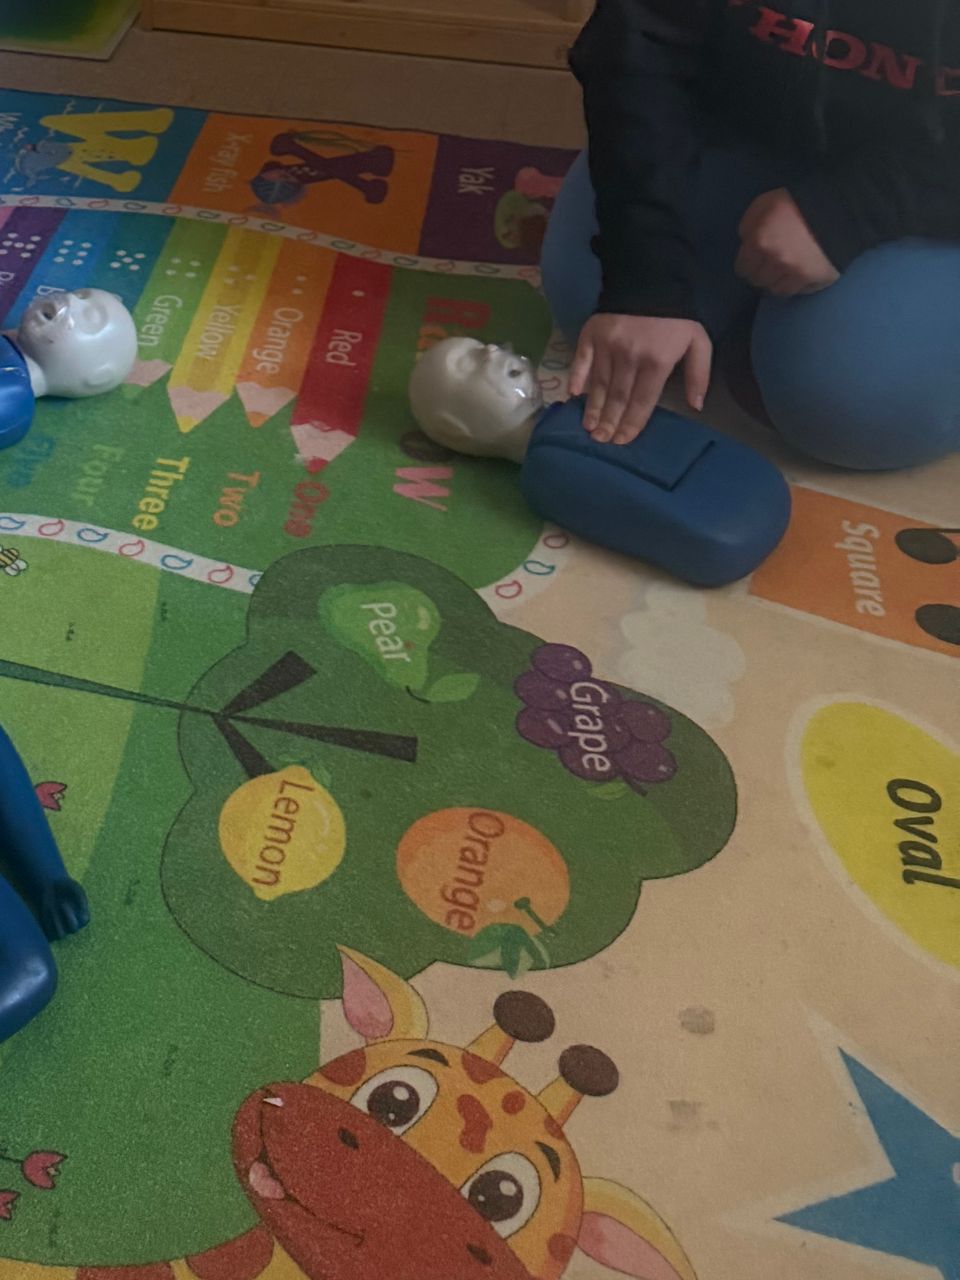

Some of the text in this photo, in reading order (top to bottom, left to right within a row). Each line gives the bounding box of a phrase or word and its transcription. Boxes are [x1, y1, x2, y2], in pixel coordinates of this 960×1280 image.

[457, 166, 495, 196] Yak
[138, 294, 183, 348] Green
[197, 303, 242, 361] Yellow
[251, 306, 304, 375] Orange
[325, 328, 363, 367] Red
[131, 456, 190, 531] Three
[212, 471, 262, 529] Two
[283, 480, 331, 539] One
[834, 519, 886, 618] Square
[359, 600, 412, 666] Pear
[568, 680, 613, 774] Grape
[251, 778, 317, 888] Lemon
[886, 776, 960, 888] Oval
[440, 810, 507, 933] Orange
